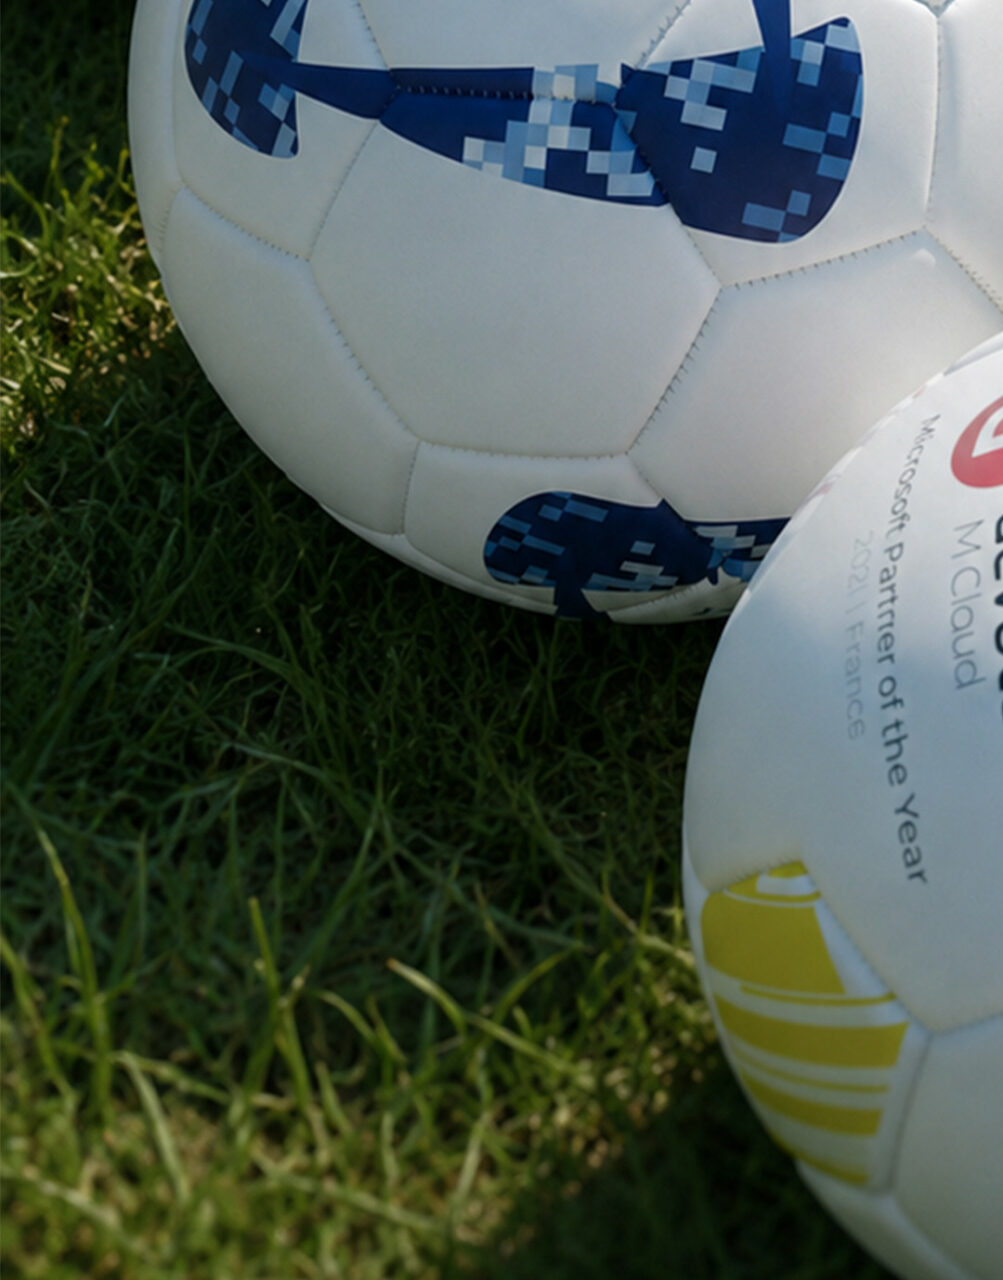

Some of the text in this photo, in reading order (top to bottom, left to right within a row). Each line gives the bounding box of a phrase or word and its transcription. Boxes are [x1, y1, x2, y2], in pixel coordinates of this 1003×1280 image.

[885, 414, 941, 539] Microsoft
[951, 519, 984, 559] M
[878, 675, 904, 710] of
[881, 719, 909, 787] the
[894, 791, 929, 883] Year
